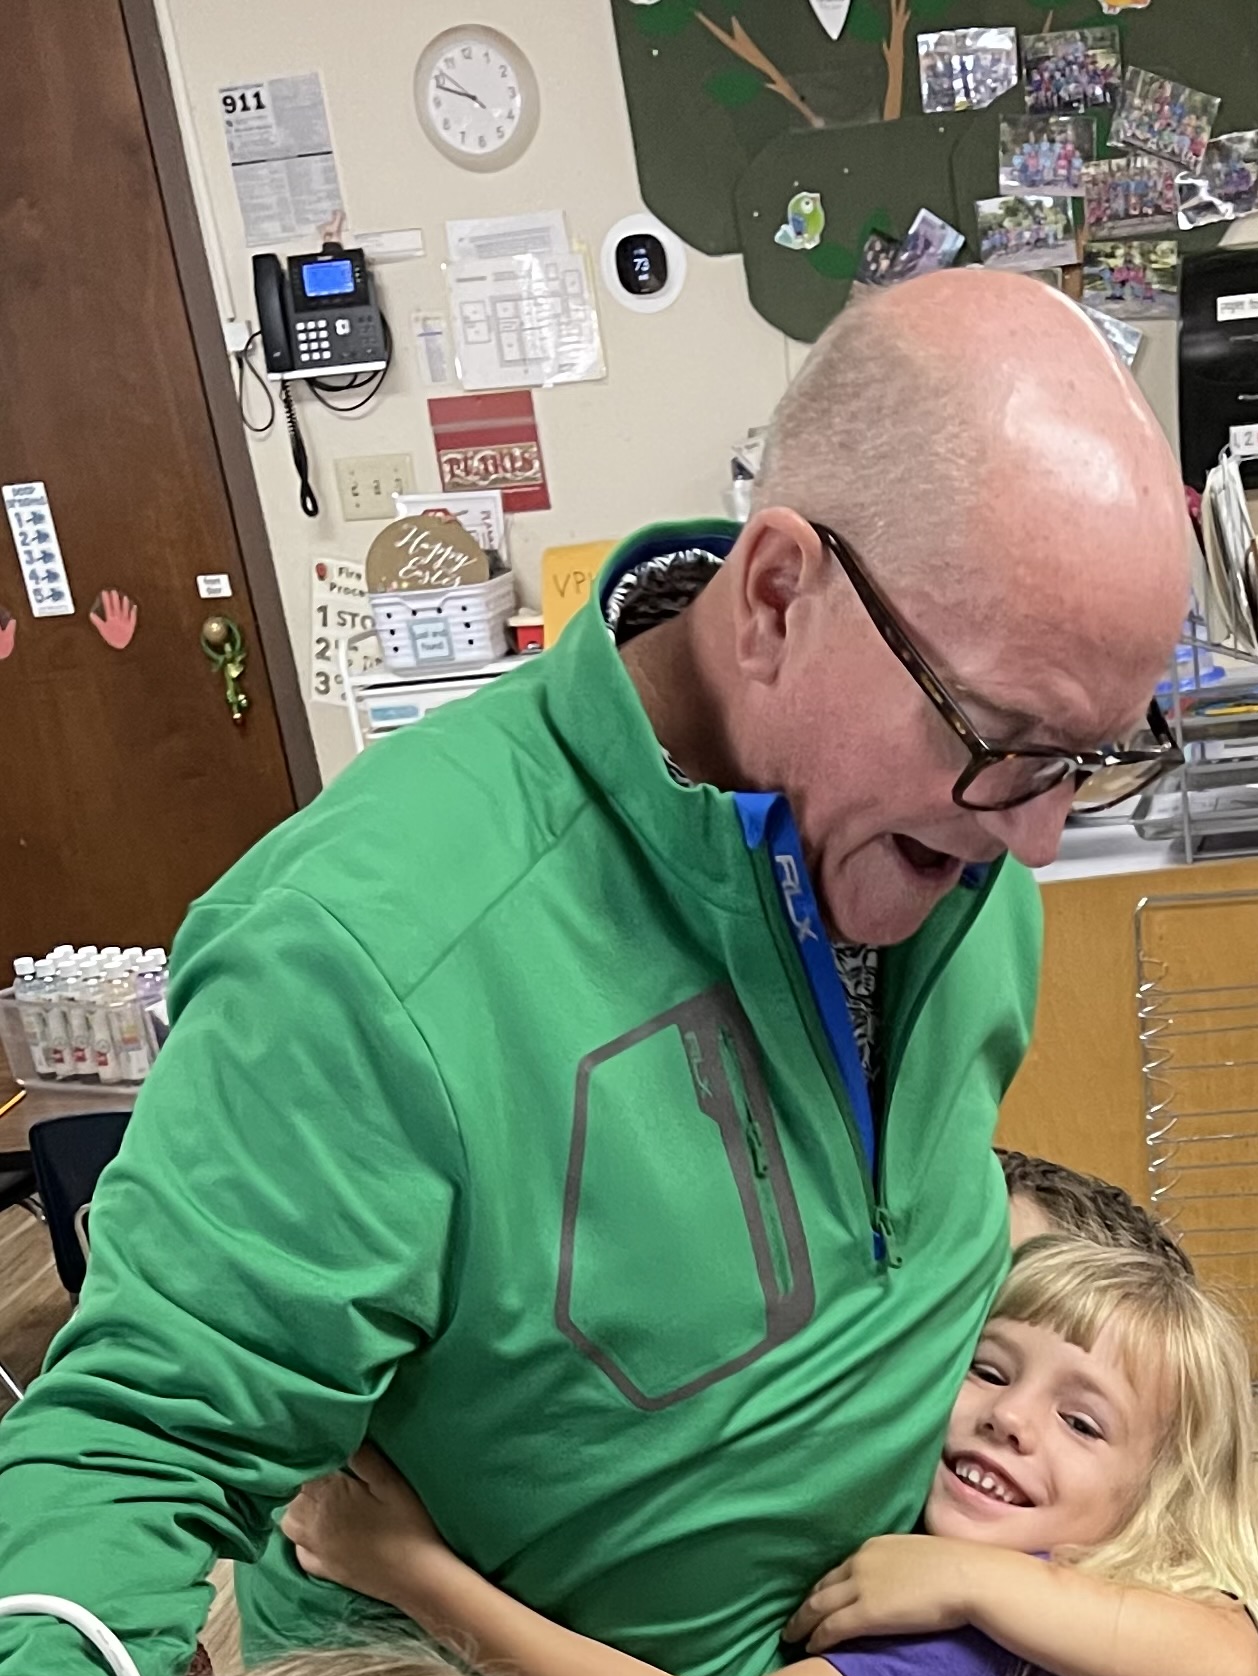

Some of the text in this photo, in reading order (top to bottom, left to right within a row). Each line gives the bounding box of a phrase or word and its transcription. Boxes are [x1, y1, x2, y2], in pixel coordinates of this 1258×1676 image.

[222, 91, 266, 114] 911
[633, 258, 650, 271] 73
[19, 531, 31, 546] 2
[394, 524, 477, 572] Happy
[338, 566, 362, 581] Fire
[552, 571, 595, 598] VP
[316, 605, 328, 628] 1
[315, 636, 331, 662] 2
[314, 671, 331, 695] 3
[775, 854, 819, 942] RLX
